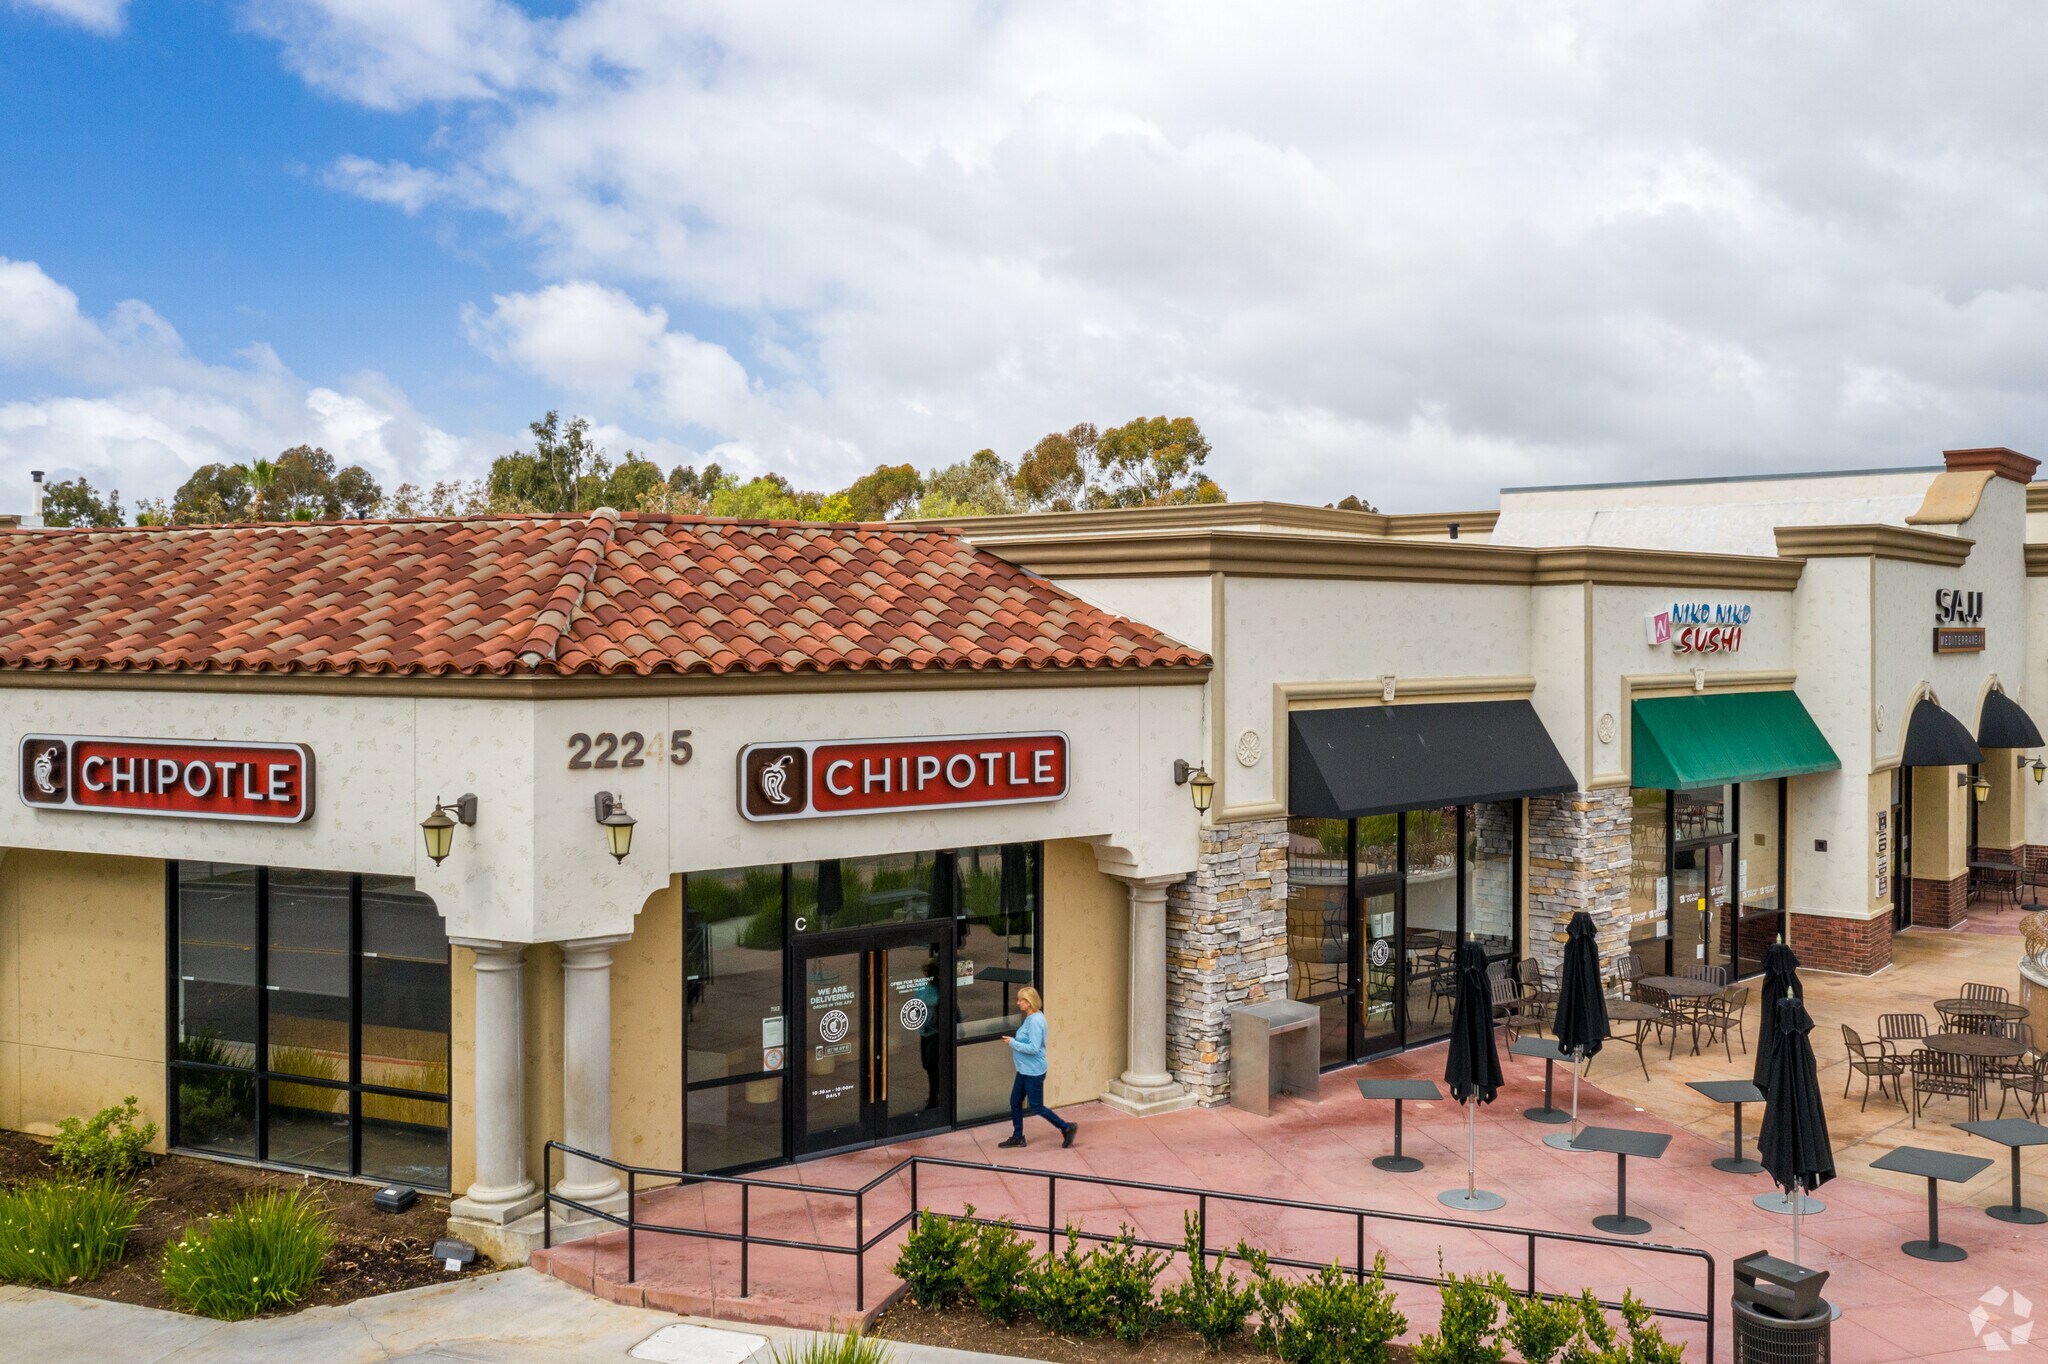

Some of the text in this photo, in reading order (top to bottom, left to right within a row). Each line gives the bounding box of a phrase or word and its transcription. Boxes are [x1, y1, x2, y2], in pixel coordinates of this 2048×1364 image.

[1673, 603, 1752, 624] NIKO NIKO
[1935, 588, 1983, 622] SAJJ
[1680, 627, 1742, 653] SUSHI
[82, 755, 292, 802] CHIPOTLE
[825, 749, 1055, 796] CHIPOTLE
[795, 917, 806, 931] C
[810, 992, 855, 1005] DELIVERING
[817, 985, 848, 996] WE ARE
[901, 1001, 926, 1014] CHIPOTLE
[822, 1011, 846, 1026] CHIPOTLE
